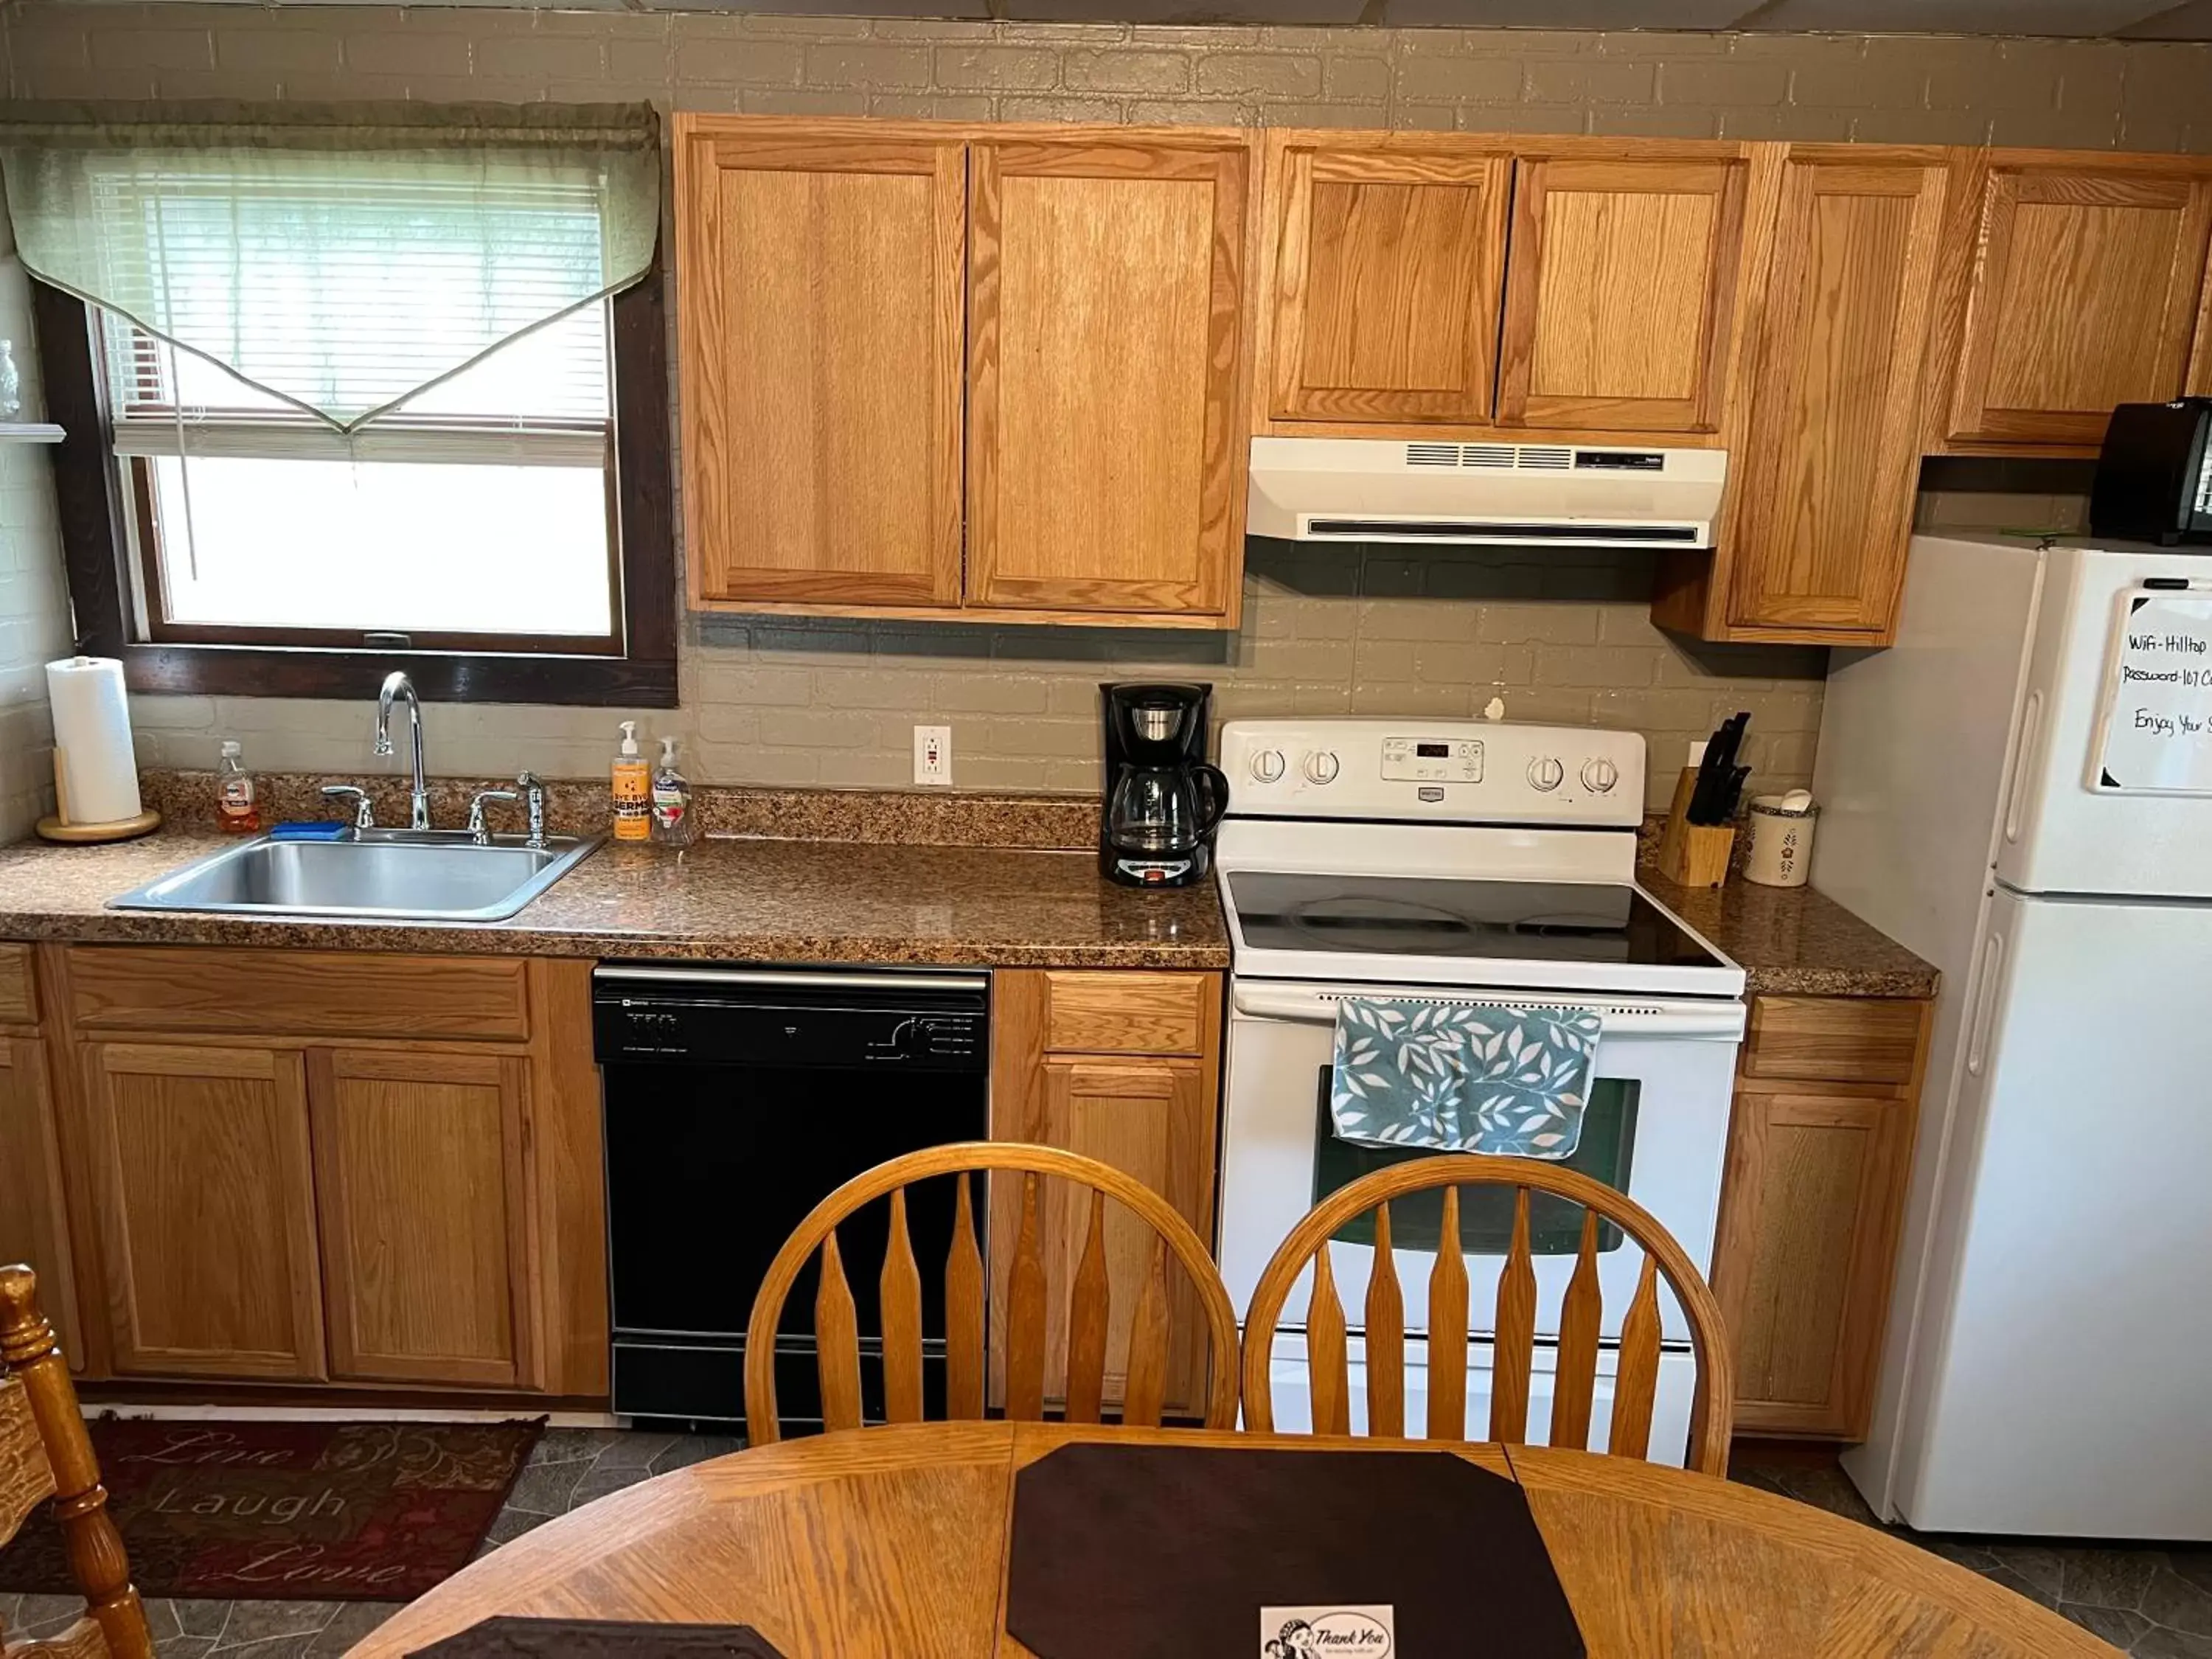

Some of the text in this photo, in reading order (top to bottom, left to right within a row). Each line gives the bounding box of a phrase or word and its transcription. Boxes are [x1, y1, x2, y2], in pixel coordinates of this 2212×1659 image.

[2135, 708, 2174, 737] Enjoy
[153, 1487, 347, 1525] Laugh
[1316, 1629, 1384, 1645] Thank You
